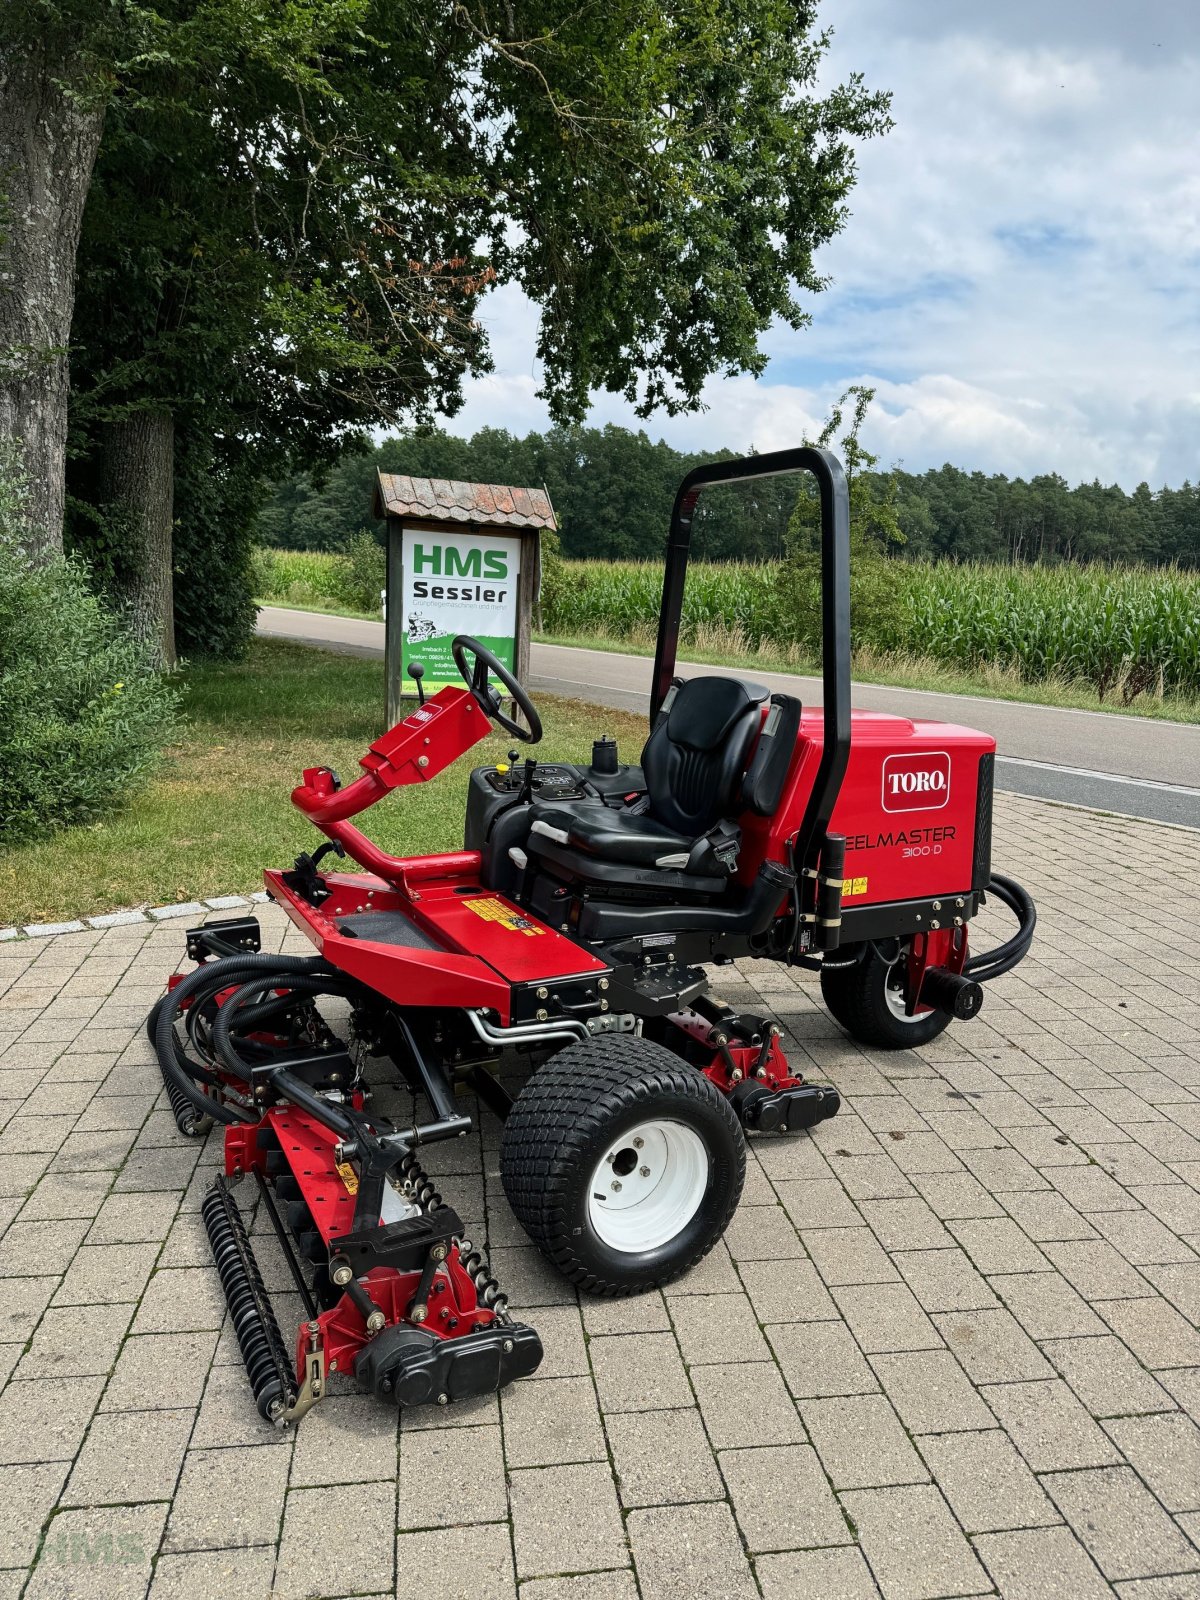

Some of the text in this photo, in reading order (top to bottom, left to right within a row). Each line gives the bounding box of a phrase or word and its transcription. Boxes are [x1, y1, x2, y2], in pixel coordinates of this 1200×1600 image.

[413, 544, 508, 579] HMS
[413, 581, 507, 603] Sessler
[888, 770, 945, 794] TORO
[845, 826, 956, 851] EELMASTER
